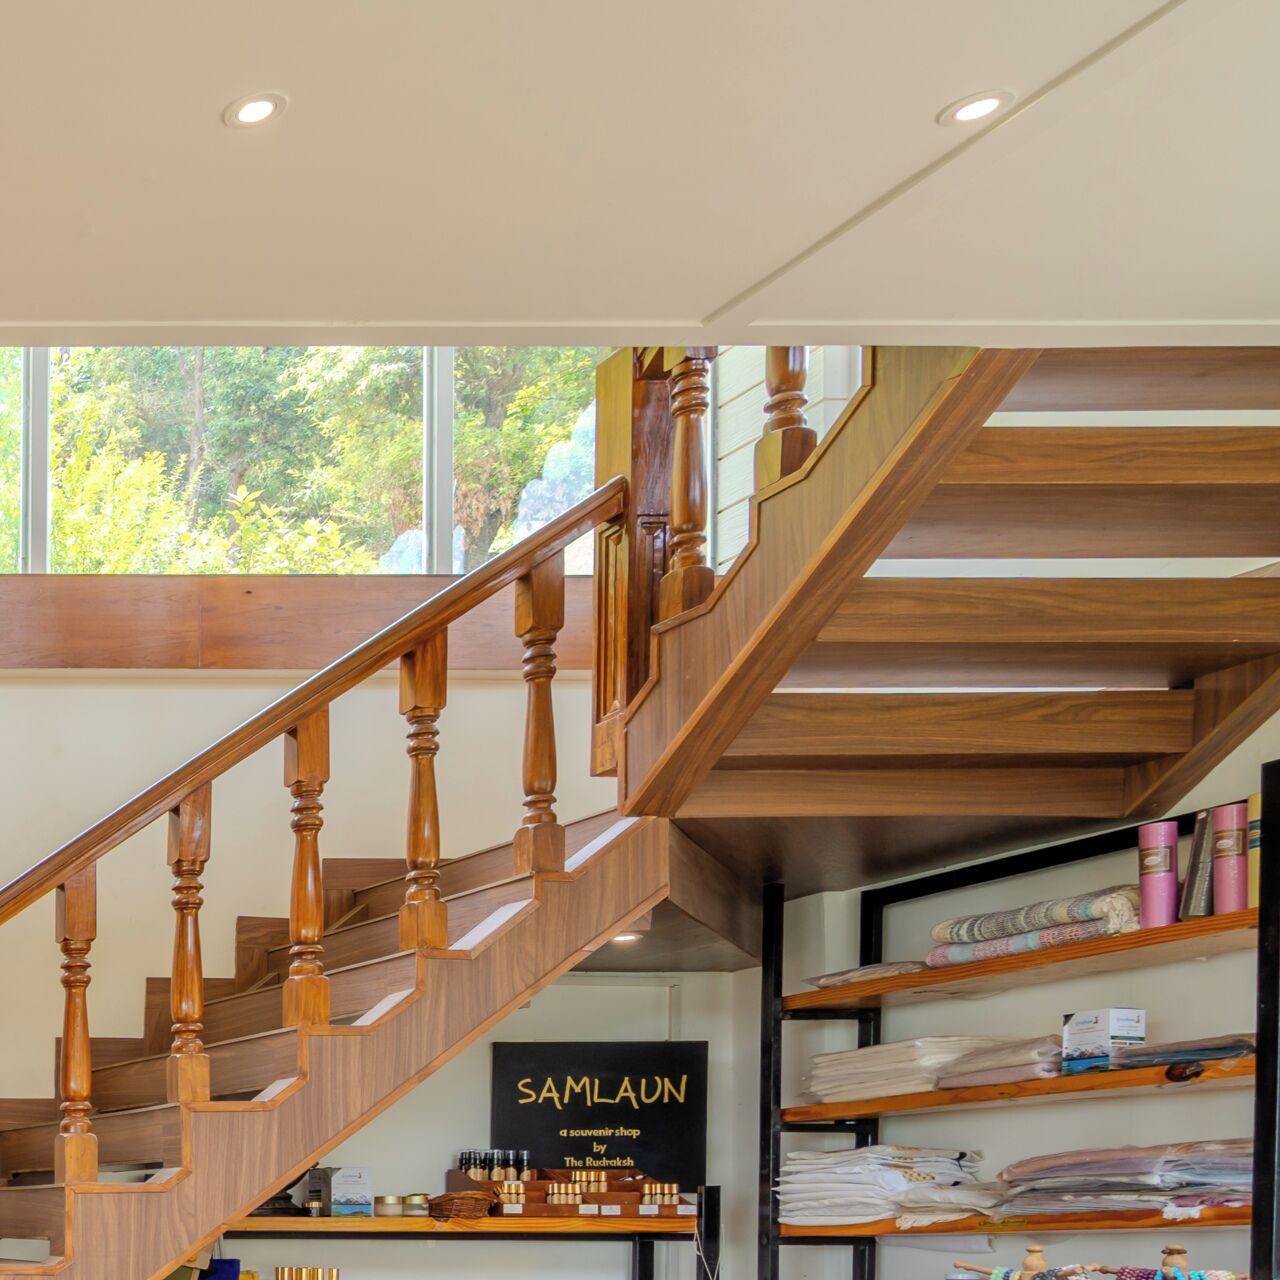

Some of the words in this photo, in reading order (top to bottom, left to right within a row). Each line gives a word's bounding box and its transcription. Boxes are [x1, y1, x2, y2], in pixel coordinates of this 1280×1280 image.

[517, 1074, 688, 1110] SAMLAUN
[559, 1127, 568, 1138] a
[569, 1126, 615, 1138] souvenir
[614, 1126, 641, 1140] shop
[592, 1142, 607, 1155] by
[564, 1156, 584, 1168] The
[585, 1156, 635, 1168] Rudraksh
